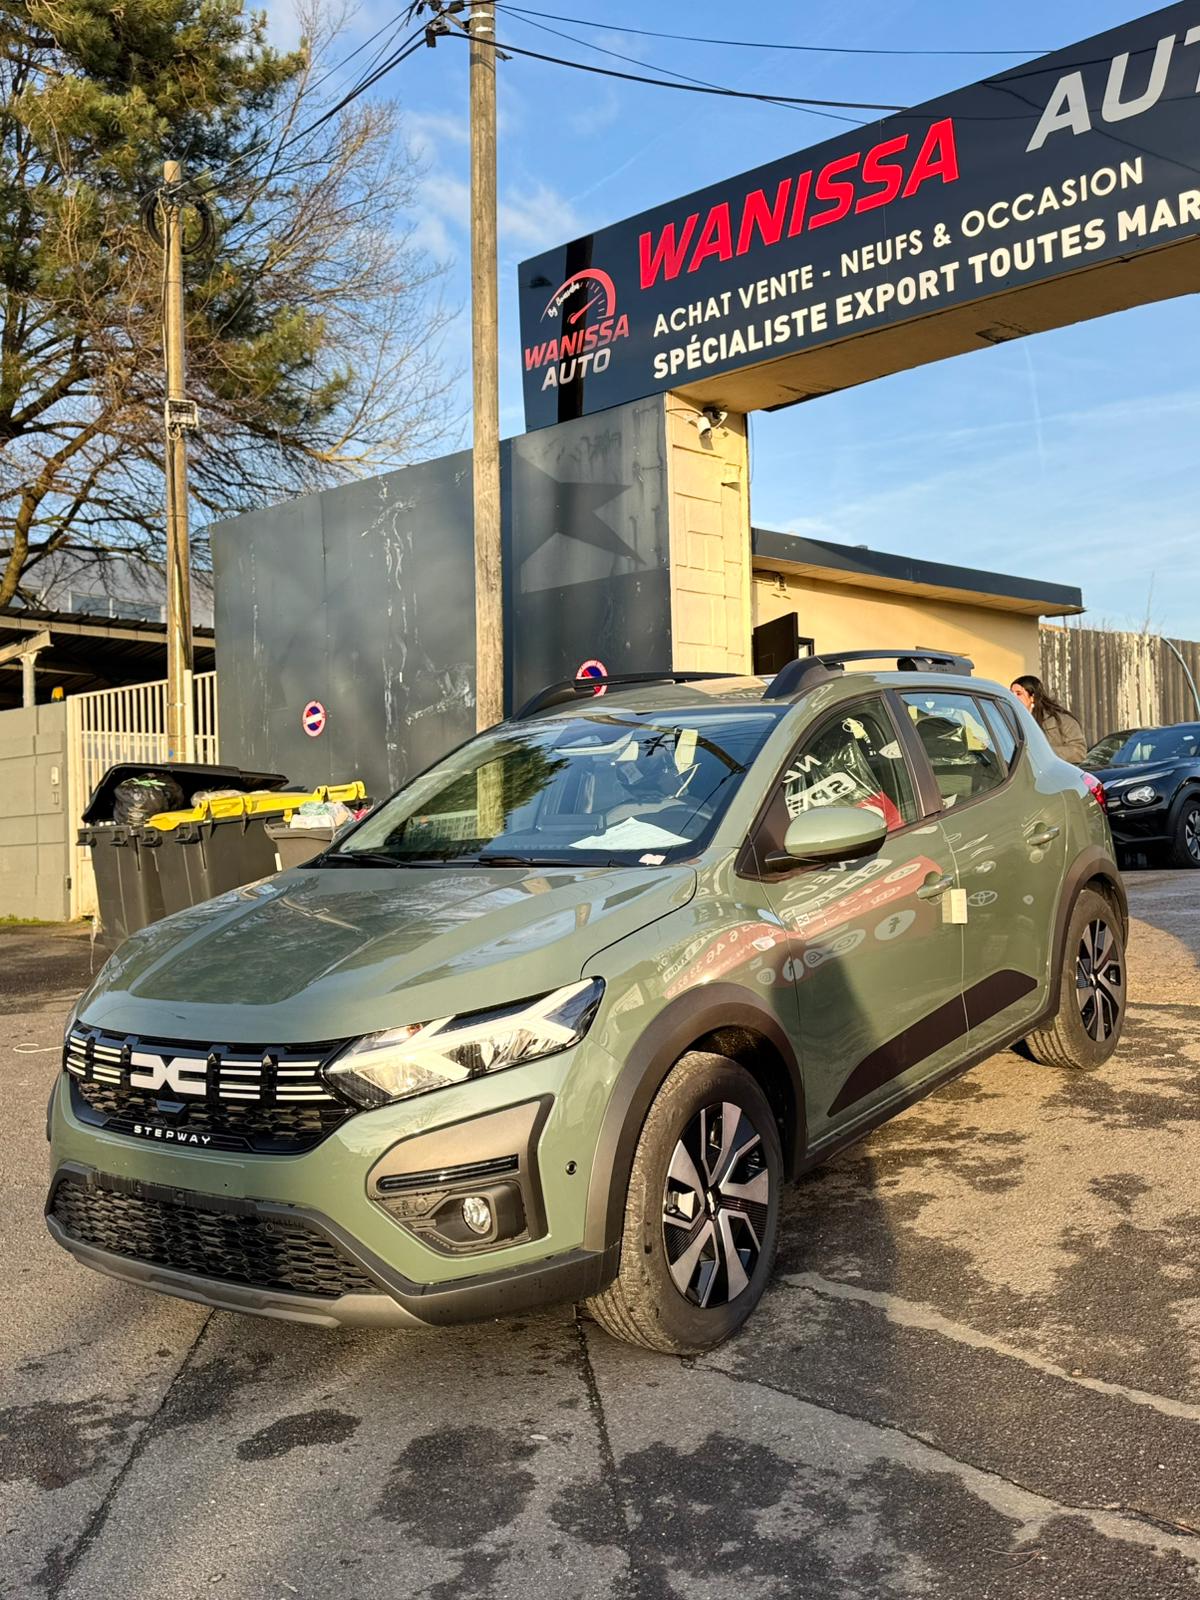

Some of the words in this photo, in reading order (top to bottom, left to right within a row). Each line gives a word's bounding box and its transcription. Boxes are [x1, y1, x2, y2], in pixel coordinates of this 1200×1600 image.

[638, 117, 959, 289] WANISSA
[1025, 25, 1200, 152] AU
[653, 291, 732, 338] ACHAT
[738, 264, 814, 309] VENTE
[822, 269, 831, 278] -
[840, 229, 924, 278] NEUFS
[933, 223, 952, 248] &
[961, 156, 1144, 238] OCCASION
[653, 302, 828, 380] SPÉCIALISTE
[836, 260, 960, 326] EXPORT
[968, 218, 1107, 284] TOUTES
[1117, 189, 1200, 242] MAR
[524, 313, 630, 371] WANISSA
[541, 348, 611, 391] AUTO
[133, 1125, 211, 1145] STEPWAY
